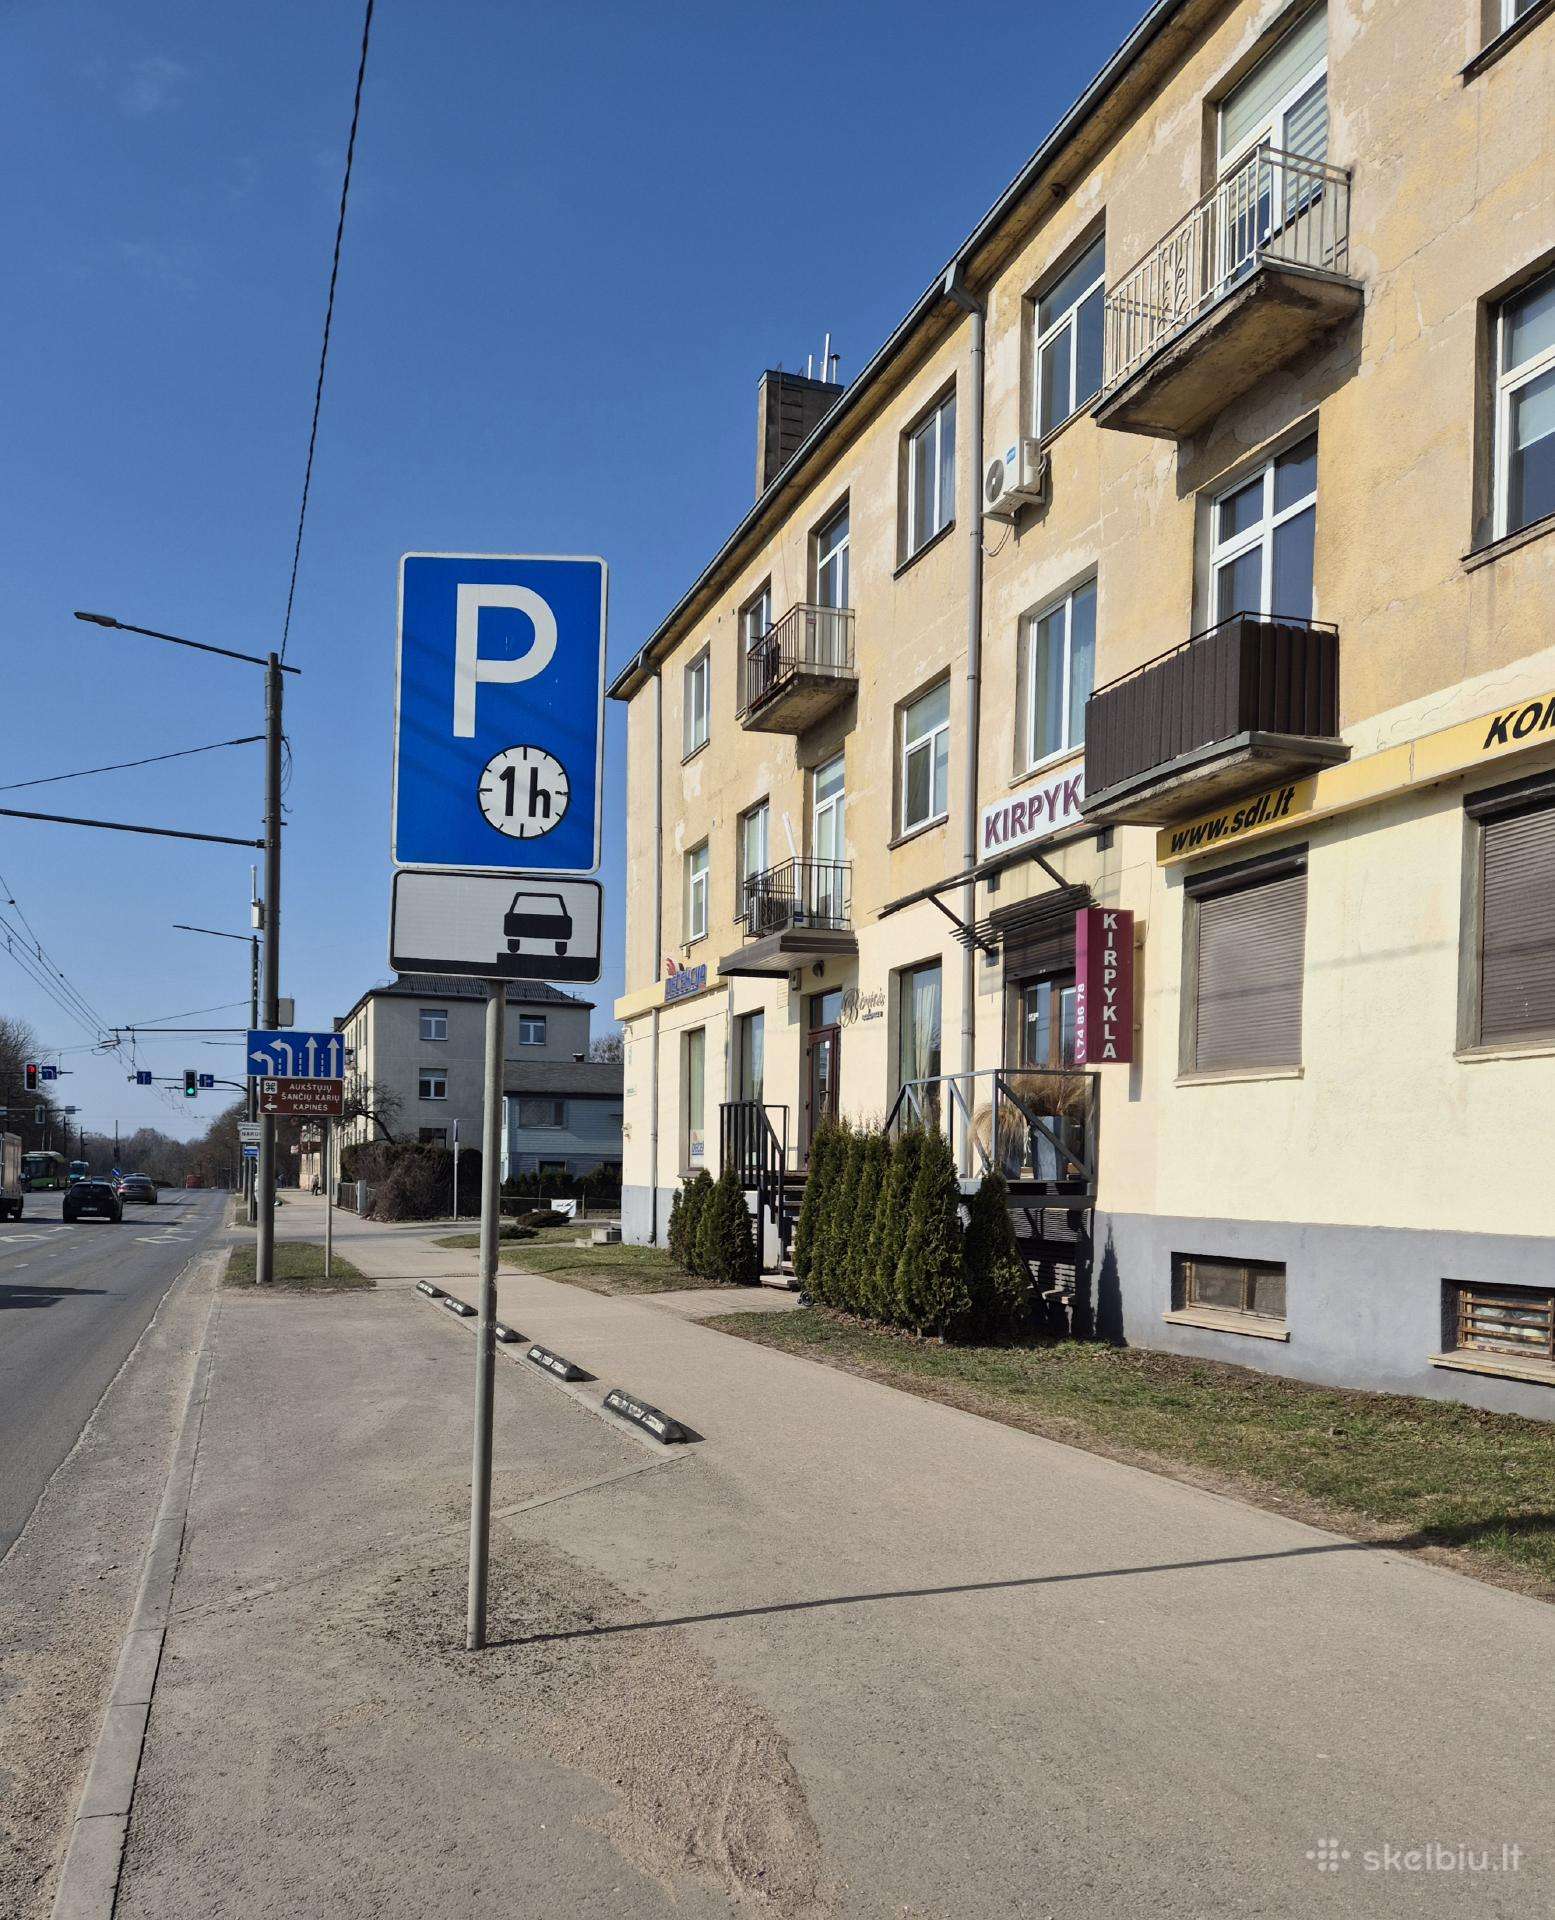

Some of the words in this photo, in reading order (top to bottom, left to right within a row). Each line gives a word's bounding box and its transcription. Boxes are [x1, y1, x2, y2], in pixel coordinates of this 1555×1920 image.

[453, 583, 557, 738] P
[1171, 786, 1295, 852] www.sdl.lt
[1102, 913, 1118, 1059] KIRPYKLA
